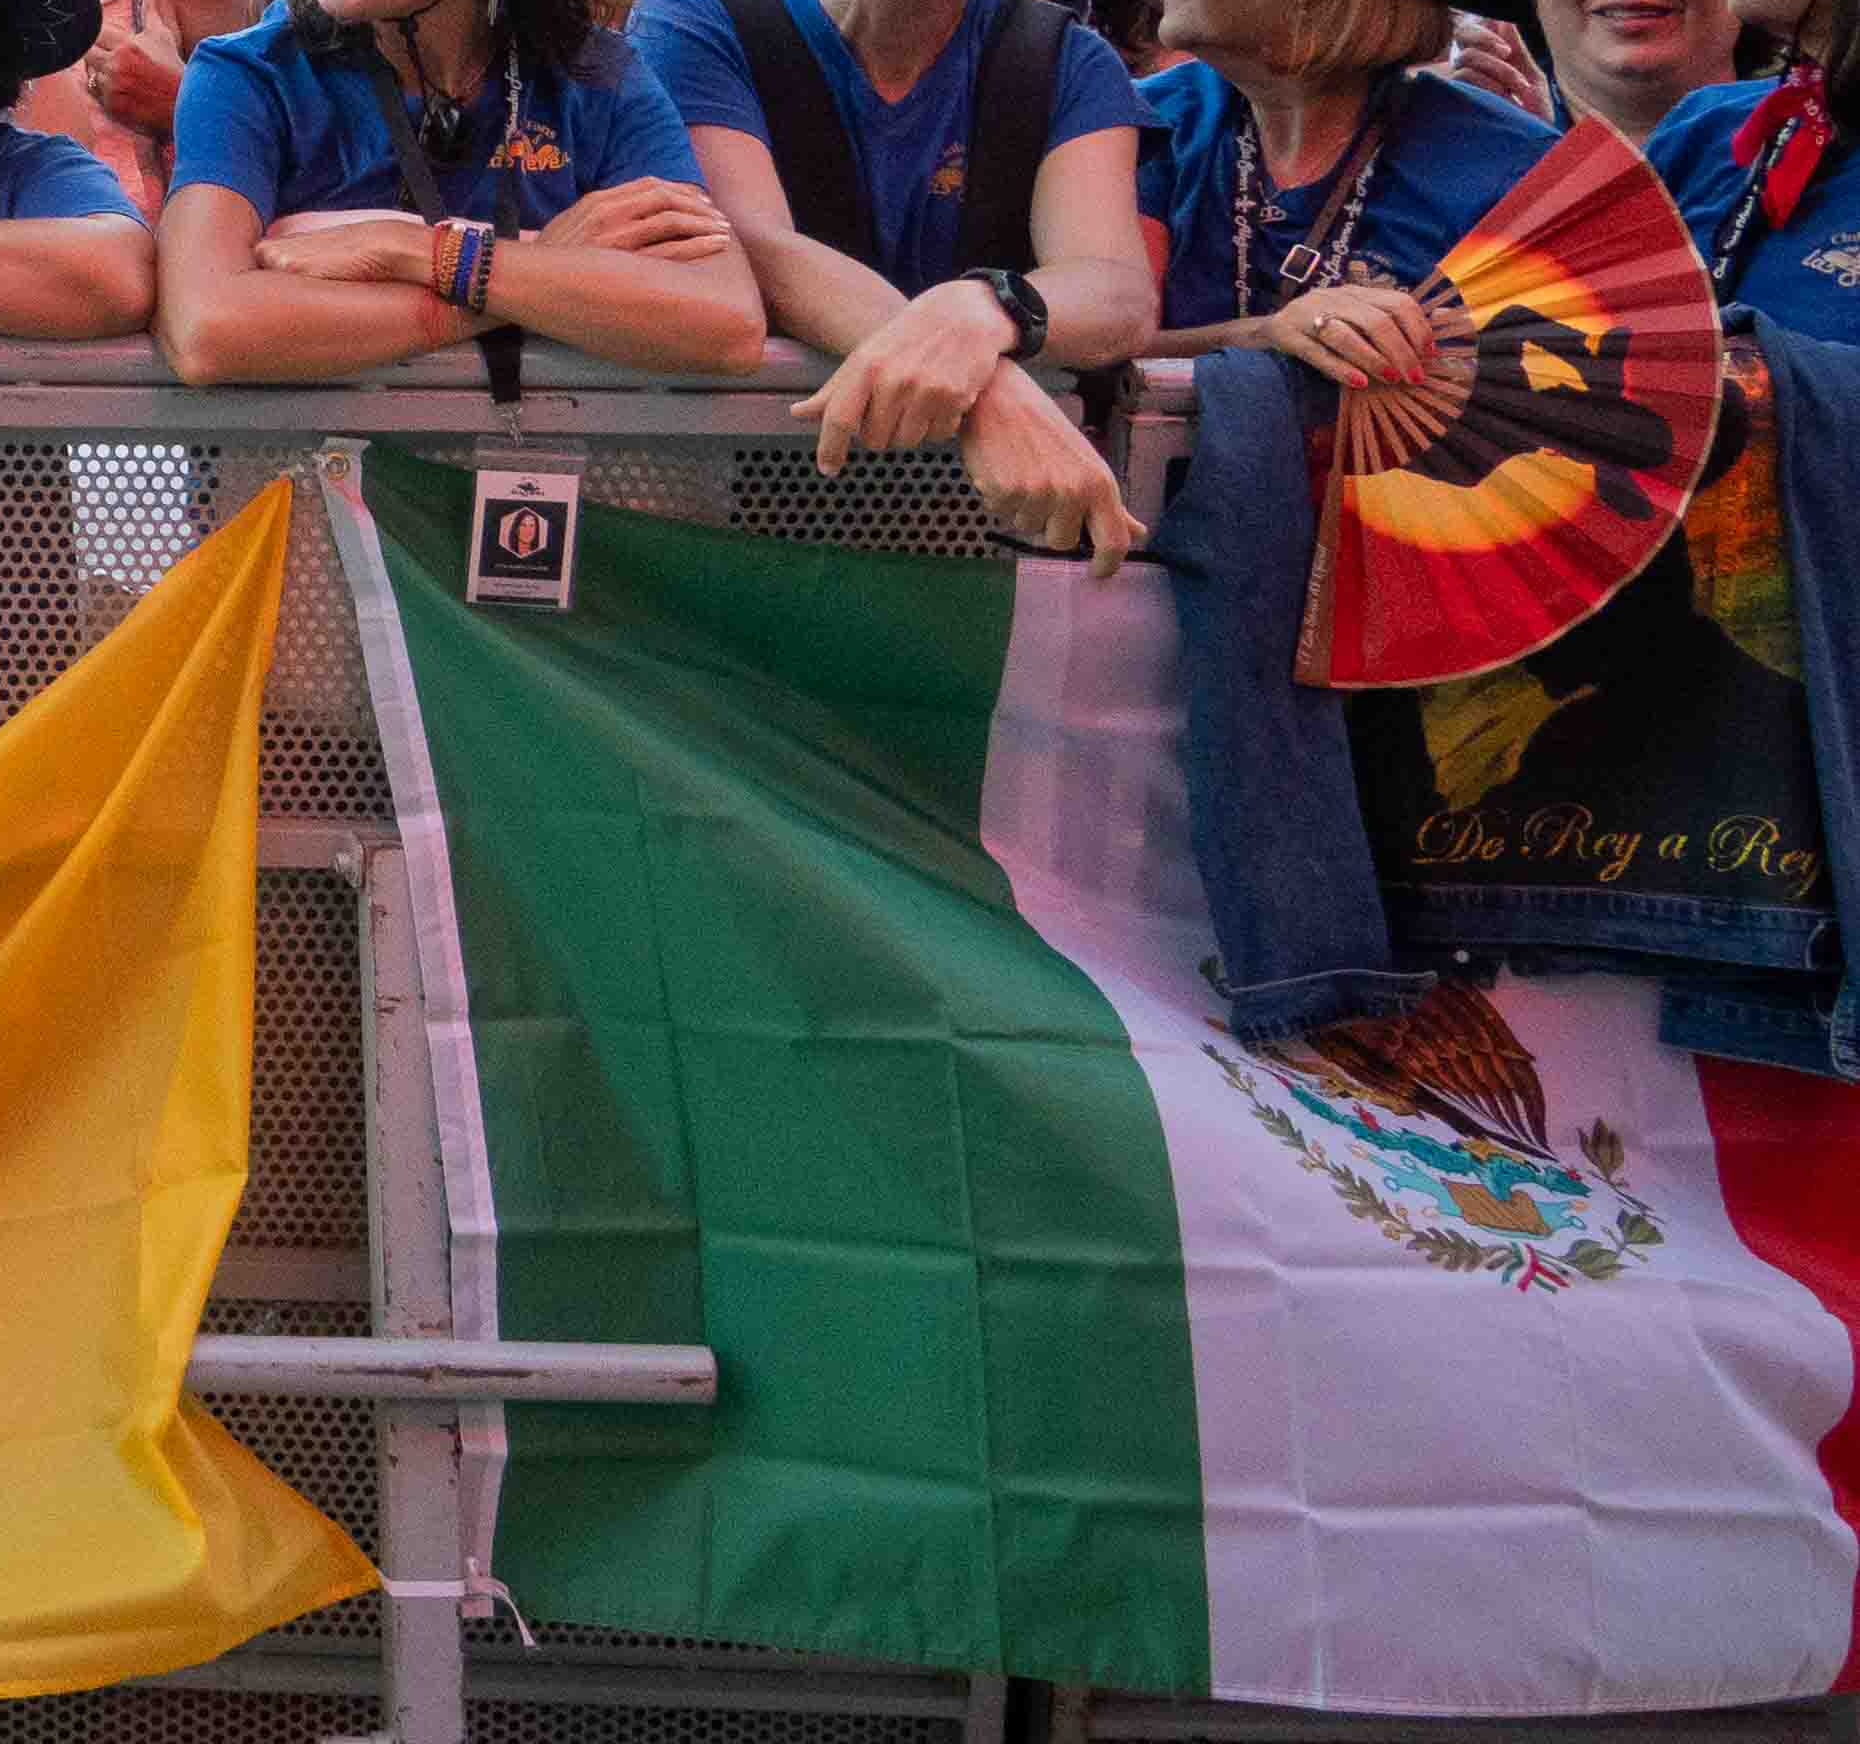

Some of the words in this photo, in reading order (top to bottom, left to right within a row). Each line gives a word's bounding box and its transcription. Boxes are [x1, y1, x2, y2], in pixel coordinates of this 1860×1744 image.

[1412, 806, 1505, 865] De
[1520, 801, 1641, 882] Rey
[1658, 832, 1689, 859] a
[1707, 813, 1819, 901] Rey
